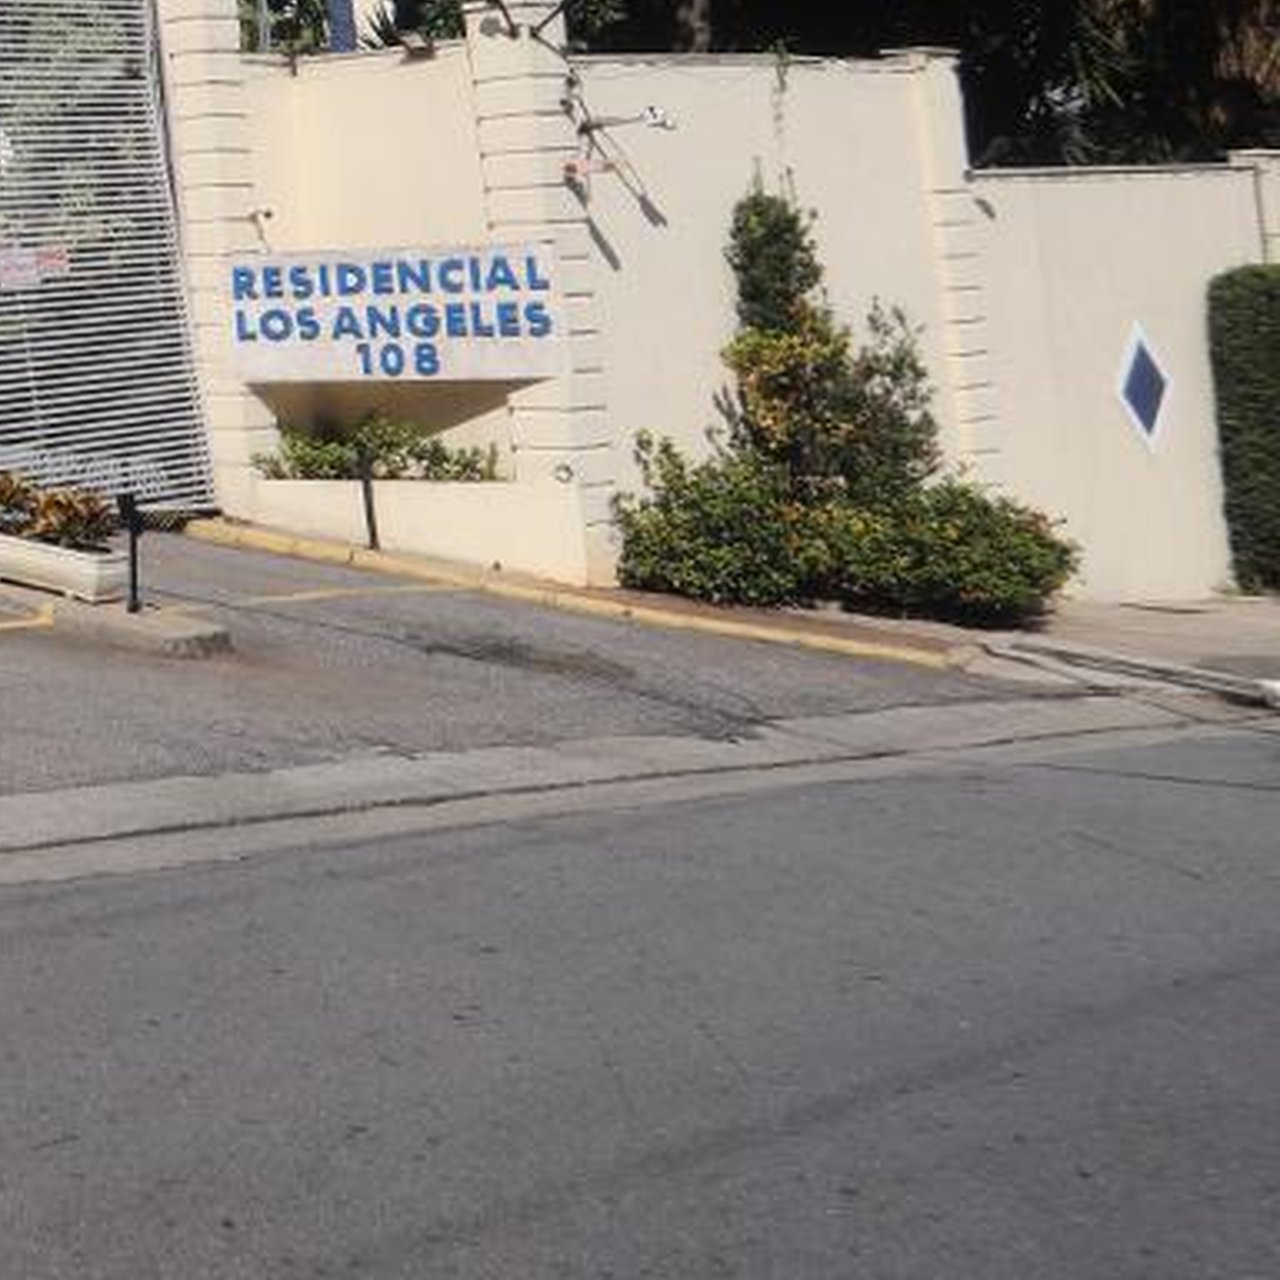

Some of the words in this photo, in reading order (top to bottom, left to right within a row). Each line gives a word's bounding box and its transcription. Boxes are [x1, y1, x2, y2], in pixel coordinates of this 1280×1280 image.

[232, 255, 550, 300] RESIDENCIAL
[236, 307, 321, 342] LOS
[332, 302, 552, 341] ANGELES
[356, 343, 440, 376] 108
